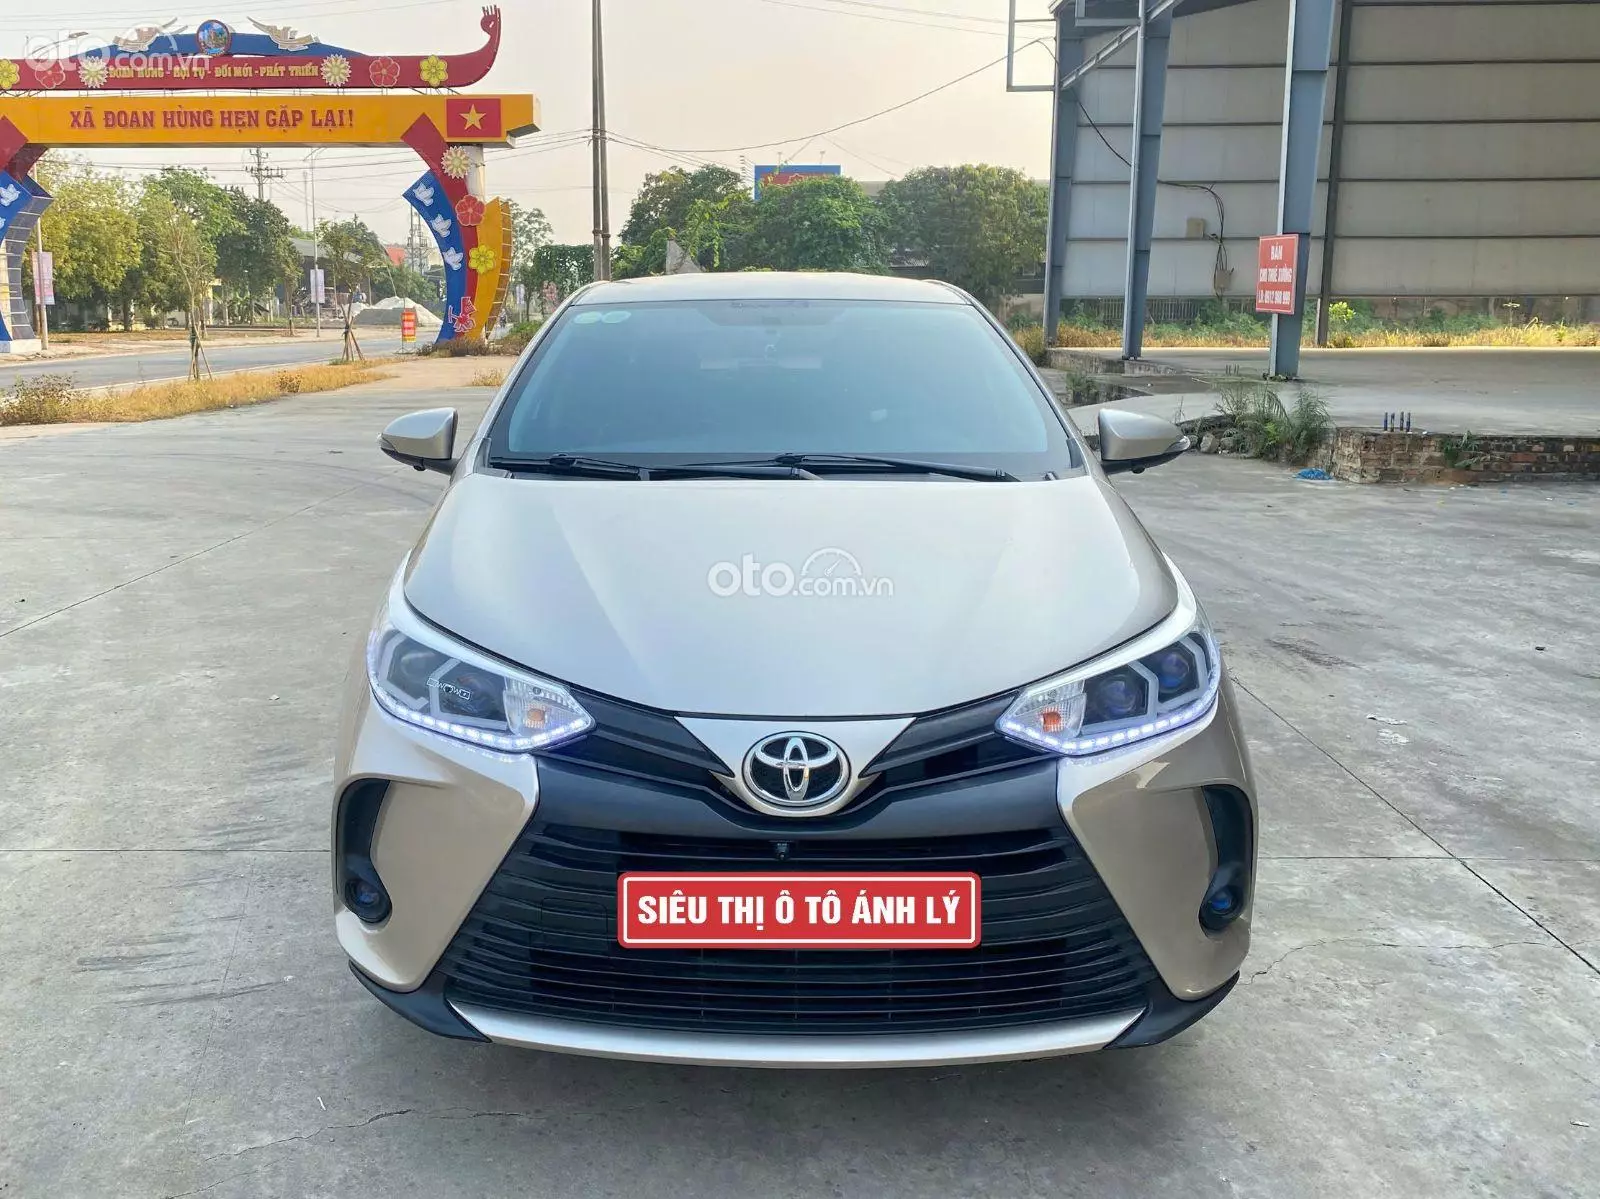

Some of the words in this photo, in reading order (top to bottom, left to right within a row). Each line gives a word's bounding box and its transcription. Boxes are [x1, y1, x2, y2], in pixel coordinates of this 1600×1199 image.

[70, 106, 96, 129] XÃ
[103, 110, 155, 129] ĐOAN
[162, 105, 214, 129] HÙNG
[220, 110, 260, 134] HẸN
[265, 105, 303, 133] GẶP
[311, 109, 354, 133] LẠI!
